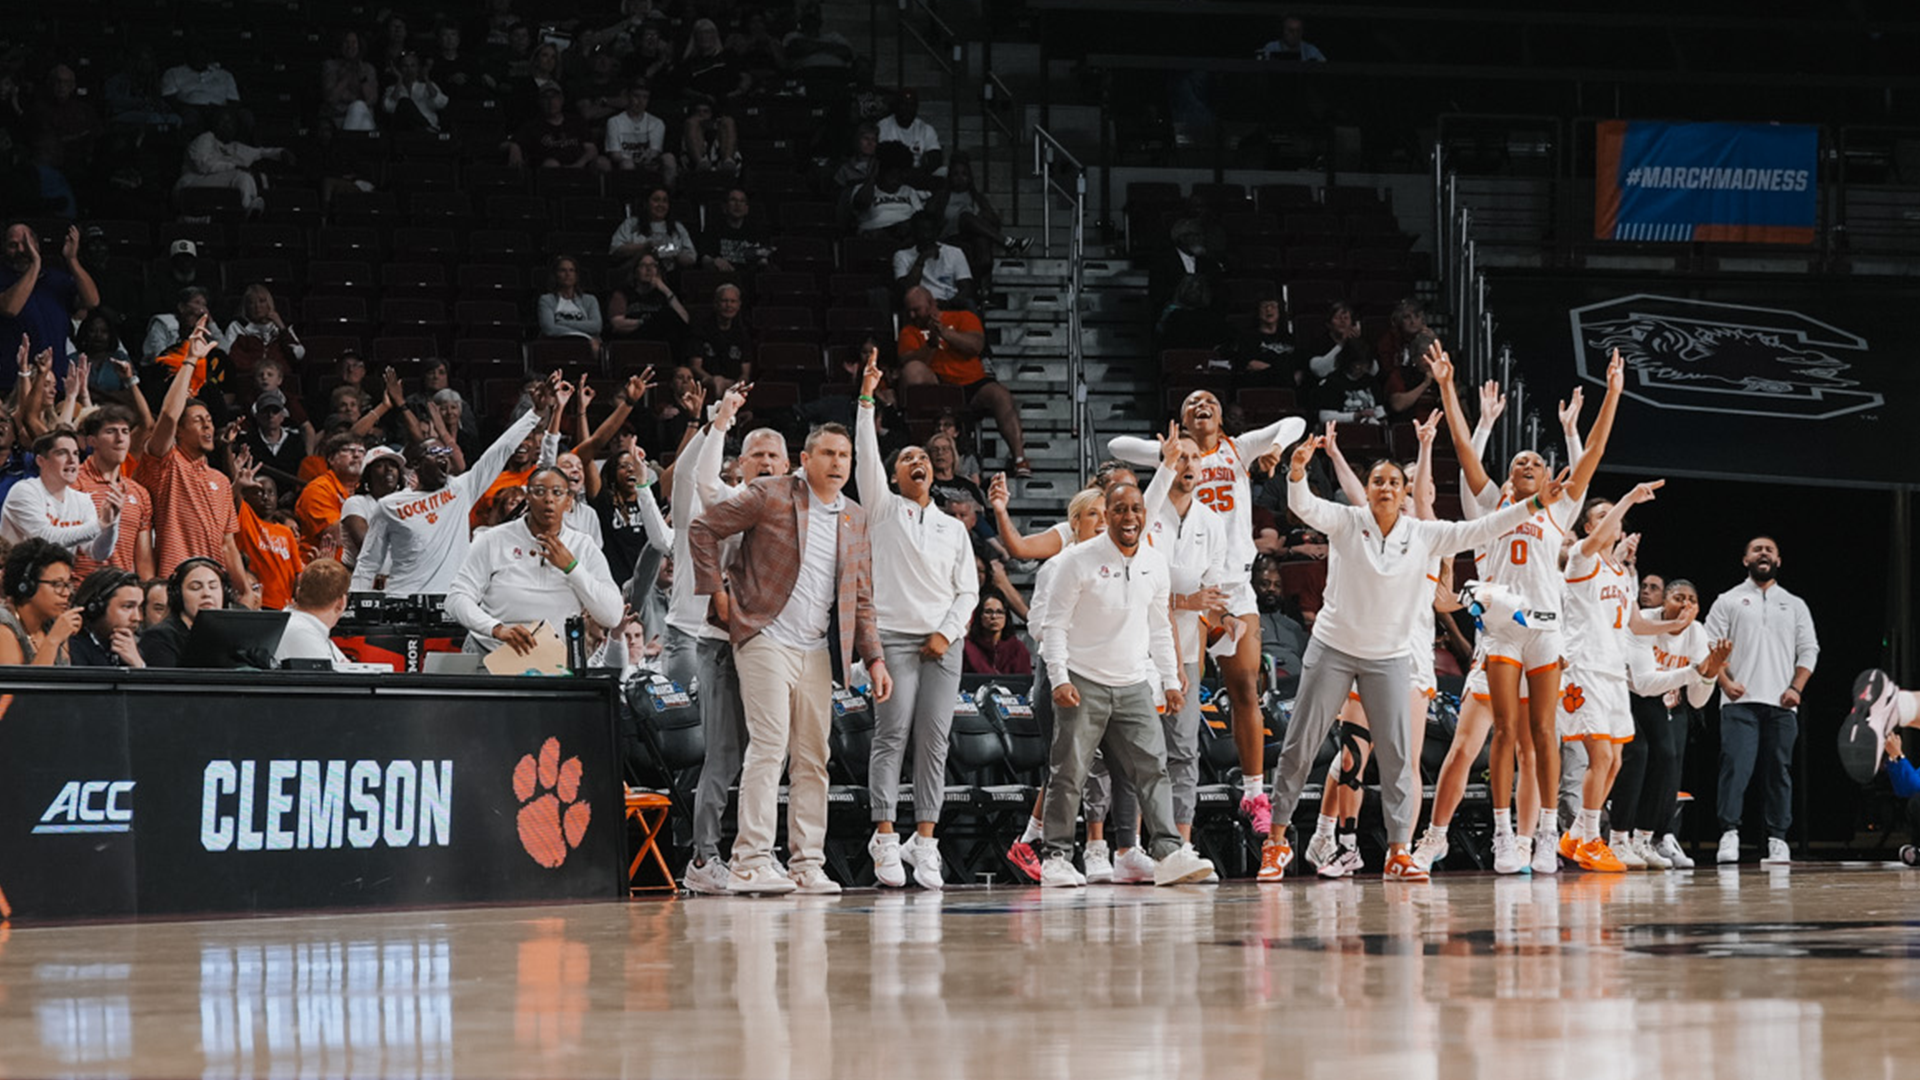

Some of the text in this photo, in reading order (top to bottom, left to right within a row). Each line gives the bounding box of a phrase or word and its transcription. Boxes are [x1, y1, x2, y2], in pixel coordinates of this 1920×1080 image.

[1625, 166, 1809, 192] #MARCHMADNESS
[396, 499, 429, 520] LOCK
[428, 493, 439, 510] IT
[1197, 485, 1234, 513] 25
[1510, 539, 1528, 565] 0
[1612, 604, 1623, 629] 1
[40, 781, 136, 822] ACC
[201, 760, 453, 851] CLEMSON
